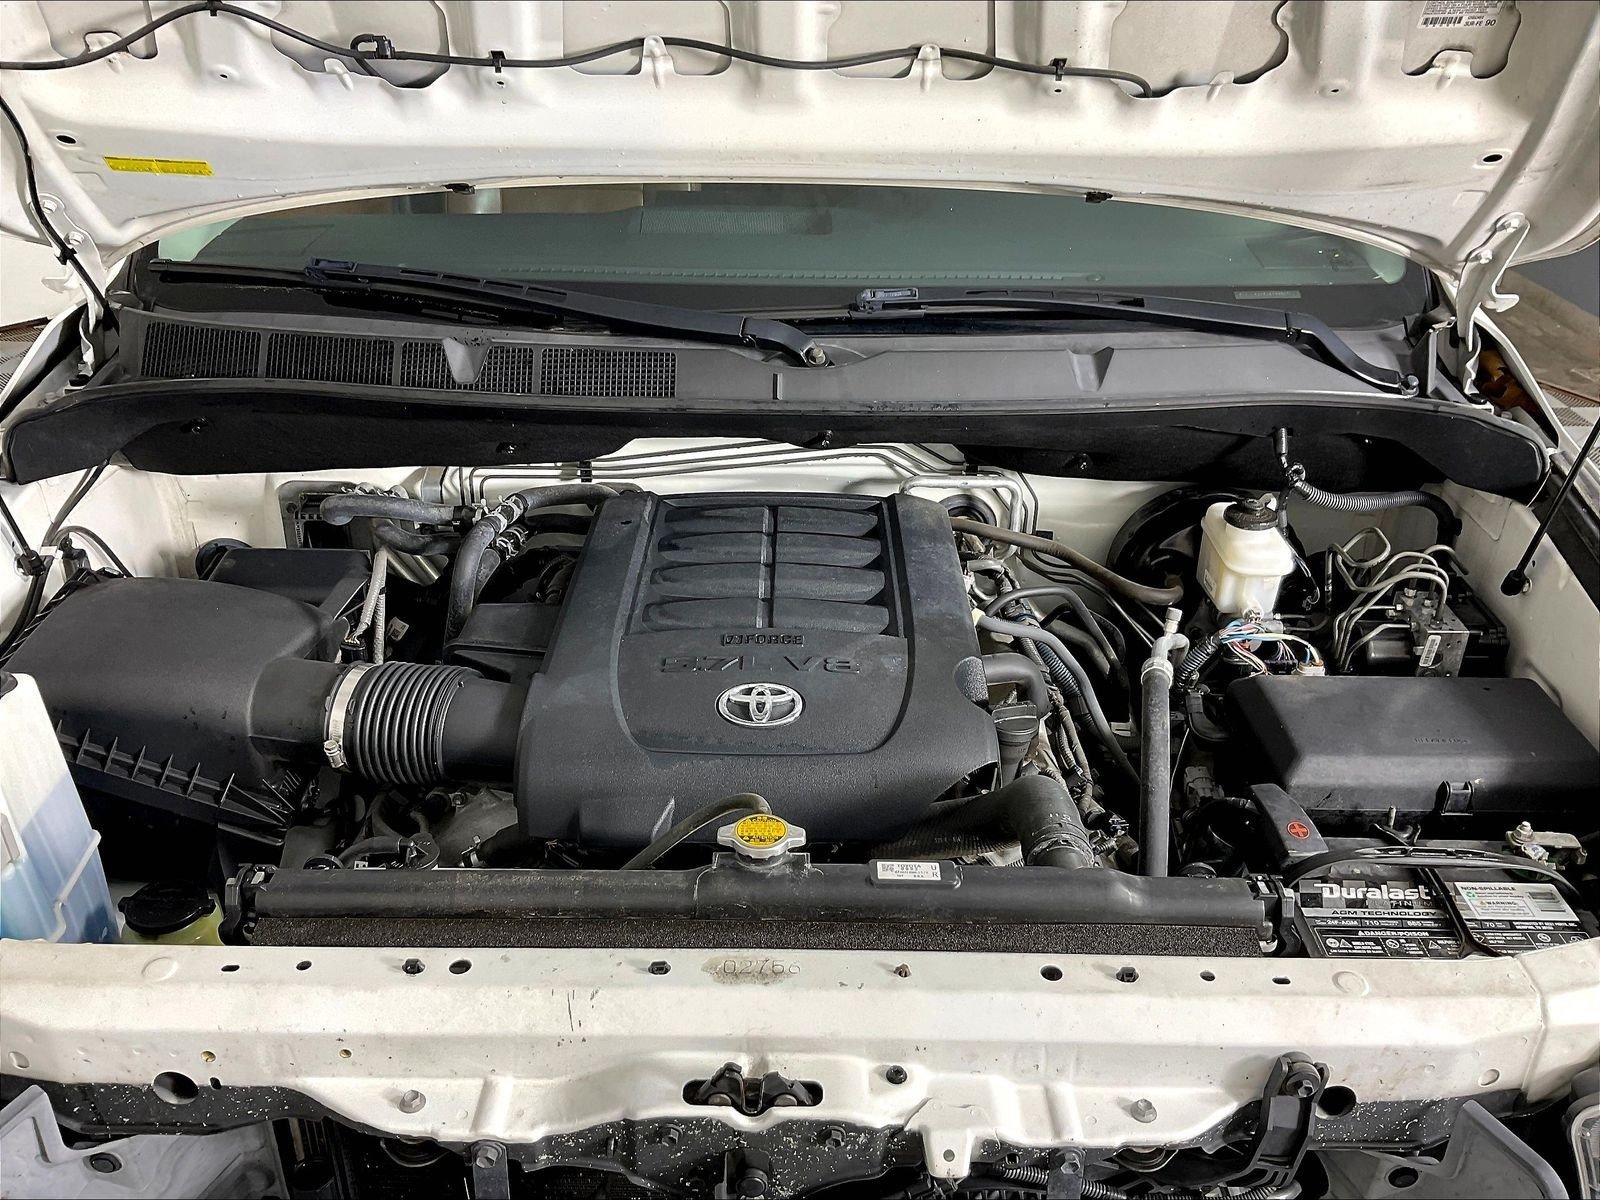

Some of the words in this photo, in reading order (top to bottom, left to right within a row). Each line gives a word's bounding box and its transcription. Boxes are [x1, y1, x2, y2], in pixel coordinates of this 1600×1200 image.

[1485, 19, 1497, 27] 90
[782, 655, 861, 674] V8
[1313, 882, 1432, 900] Duralast
